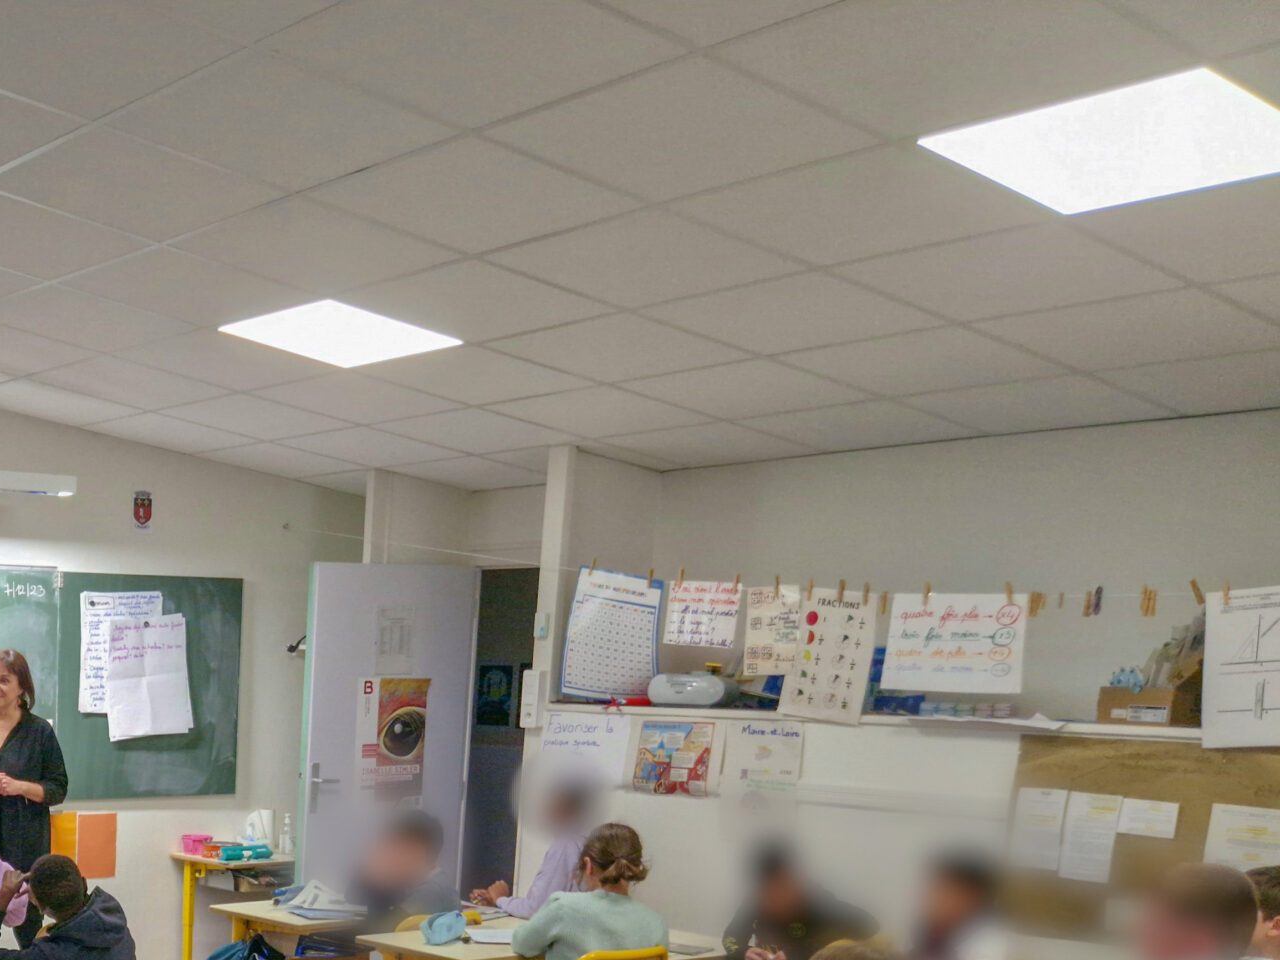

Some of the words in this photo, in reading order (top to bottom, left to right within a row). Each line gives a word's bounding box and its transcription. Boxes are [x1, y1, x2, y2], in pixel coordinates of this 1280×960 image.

[3, 581, 46, 599] 7/12/23
[818, 598, 861, 609] FRACTIONS
[900, 608, 934, 624] quatre
[364, 681, 373, 695] B
[547, 713, 599, 734] Favoriser
